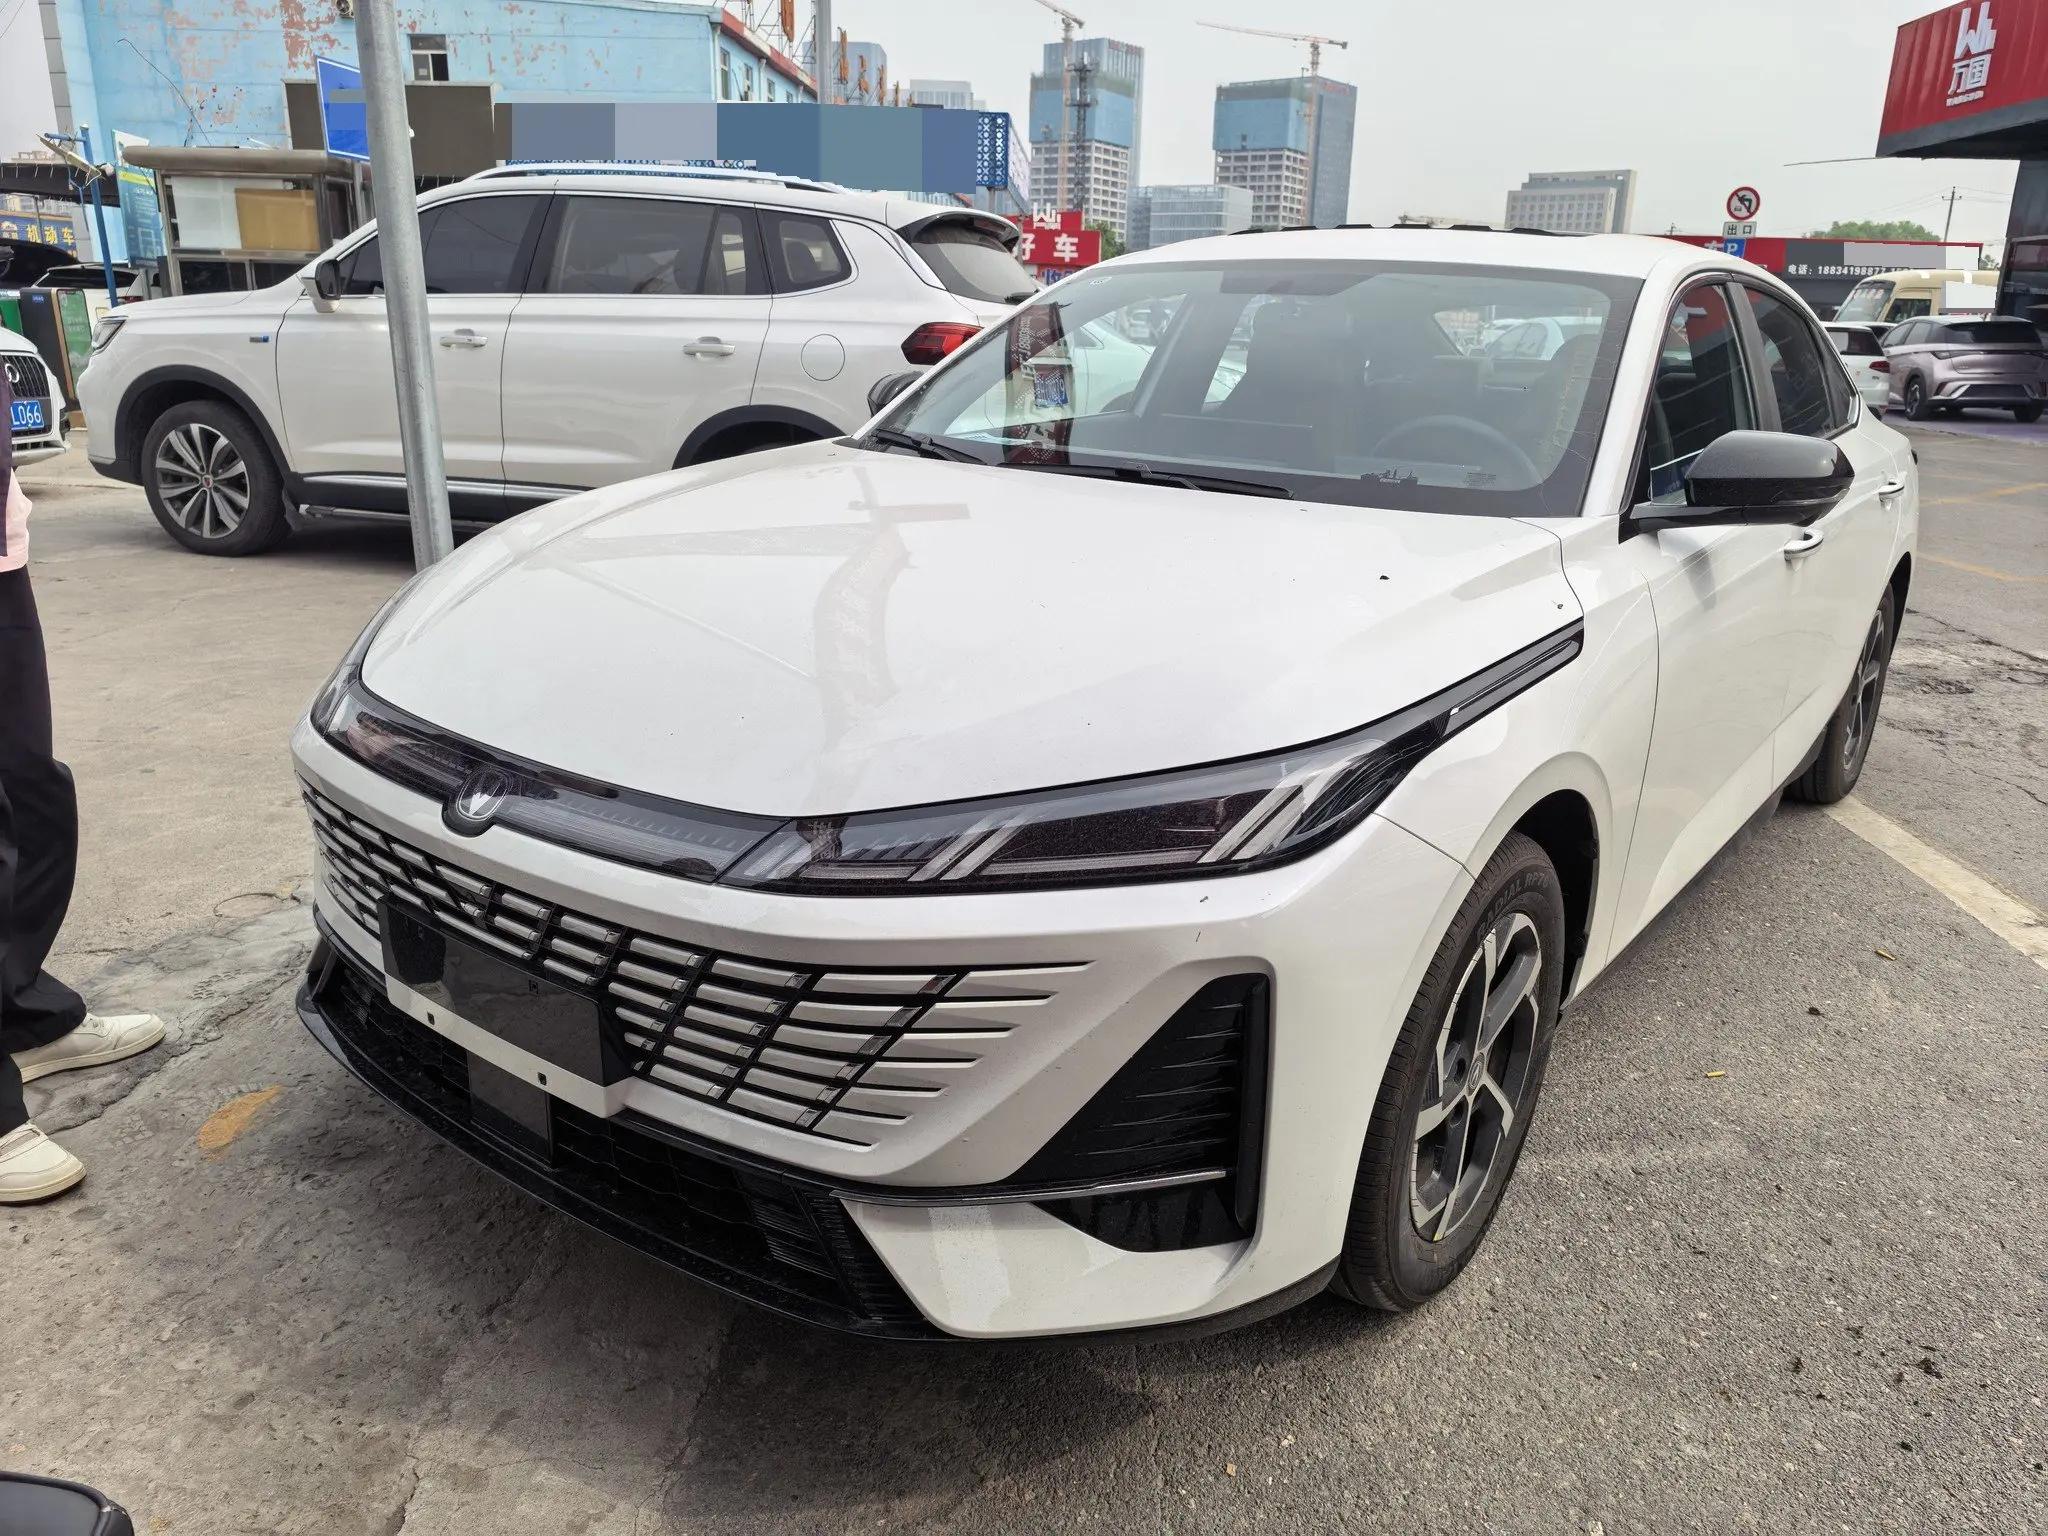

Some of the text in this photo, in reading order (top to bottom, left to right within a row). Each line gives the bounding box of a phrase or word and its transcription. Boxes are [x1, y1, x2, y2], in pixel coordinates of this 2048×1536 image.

[1948, 54, 1992, 95] 万国
[27, 224, 76, 245] 机动车
[1728, 224, 1752, 235] 出口
[1727, 243, 1738, 254] P
[11, 404, 42, 426] L066
